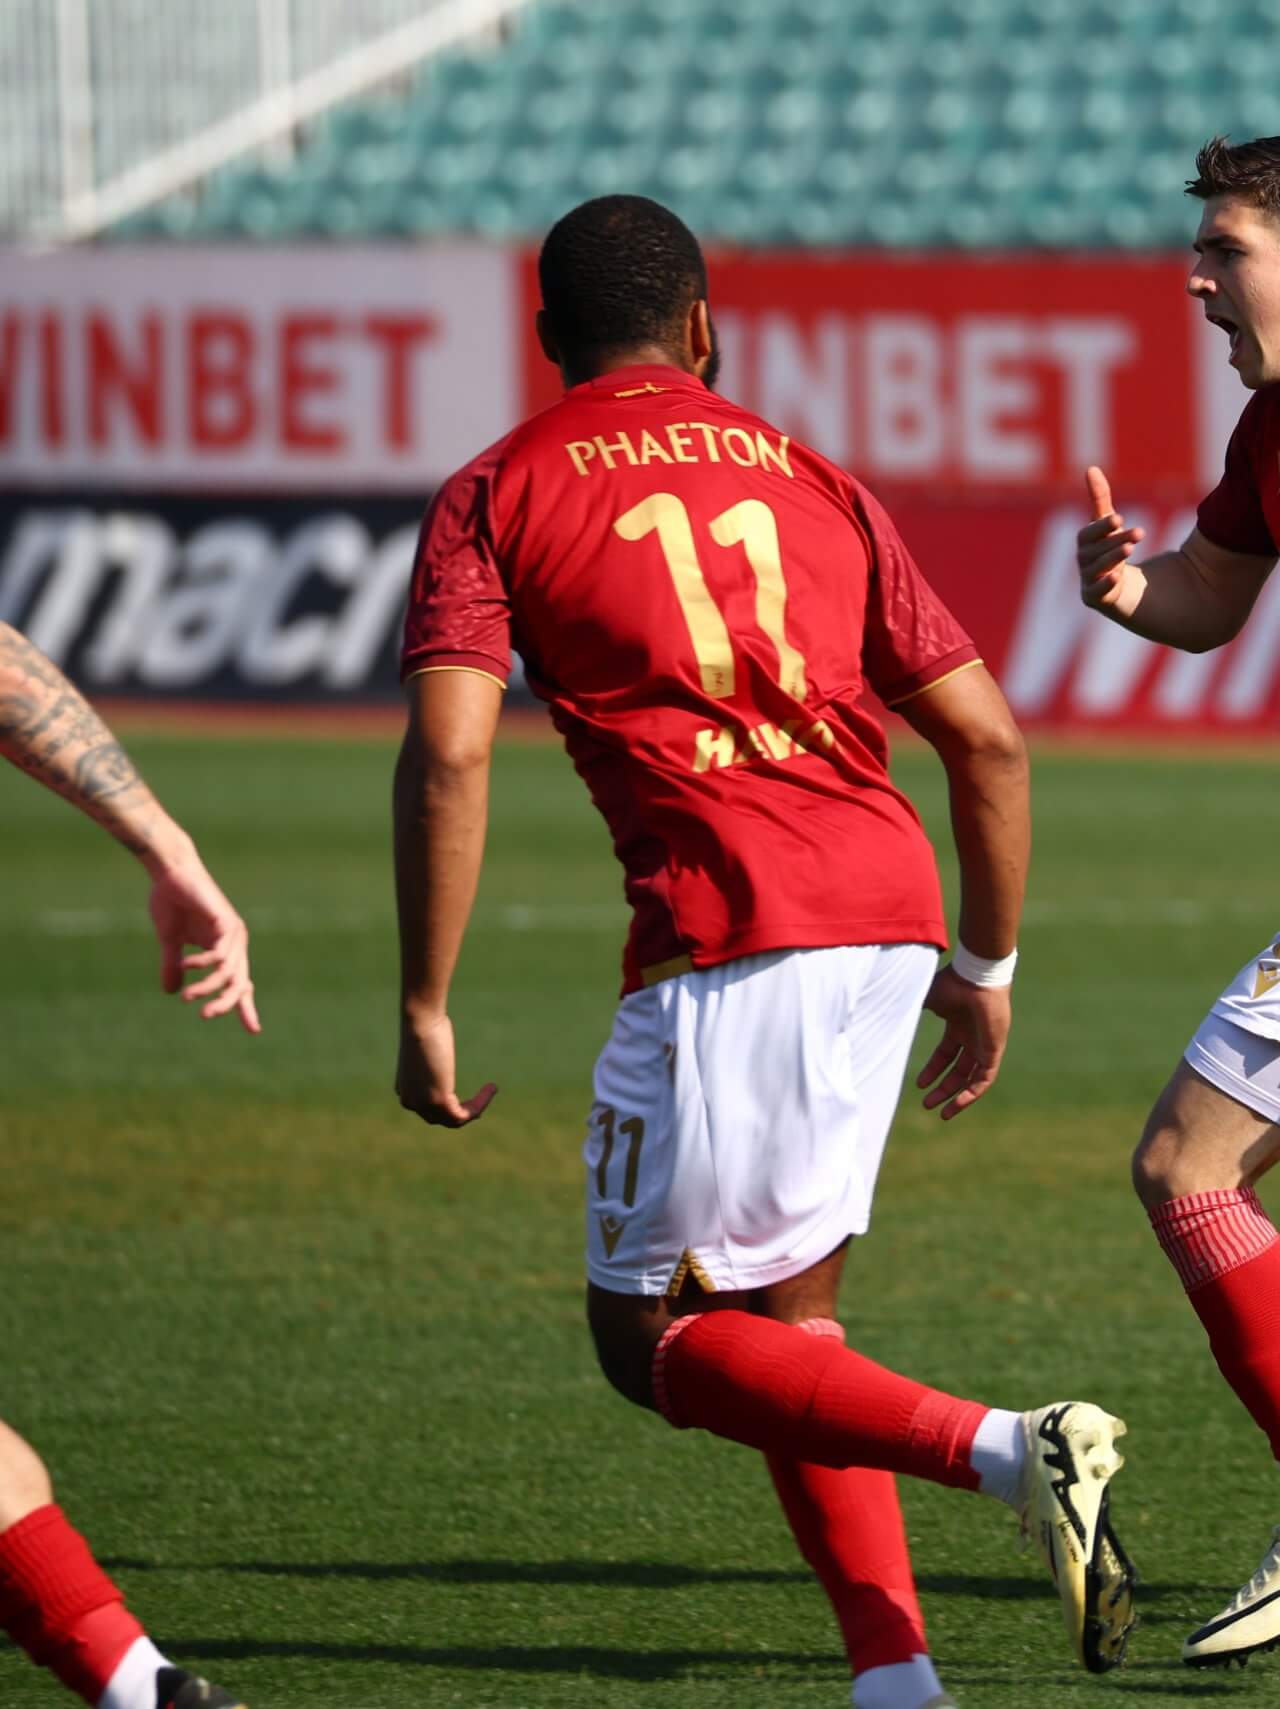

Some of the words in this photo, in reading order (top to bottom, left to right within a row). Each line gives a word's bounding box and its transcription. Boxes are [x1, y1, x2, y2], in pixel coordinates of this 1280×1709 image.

[0, 310, 440, 452] INBET
[565, 422, 795, 479] PHAETON
[712, 314, 1137, 478] INBET
[0, 510, 426, 686] macr
[613, 492, 808, 704] 11
[597, 1107, 645, 1209] 11
